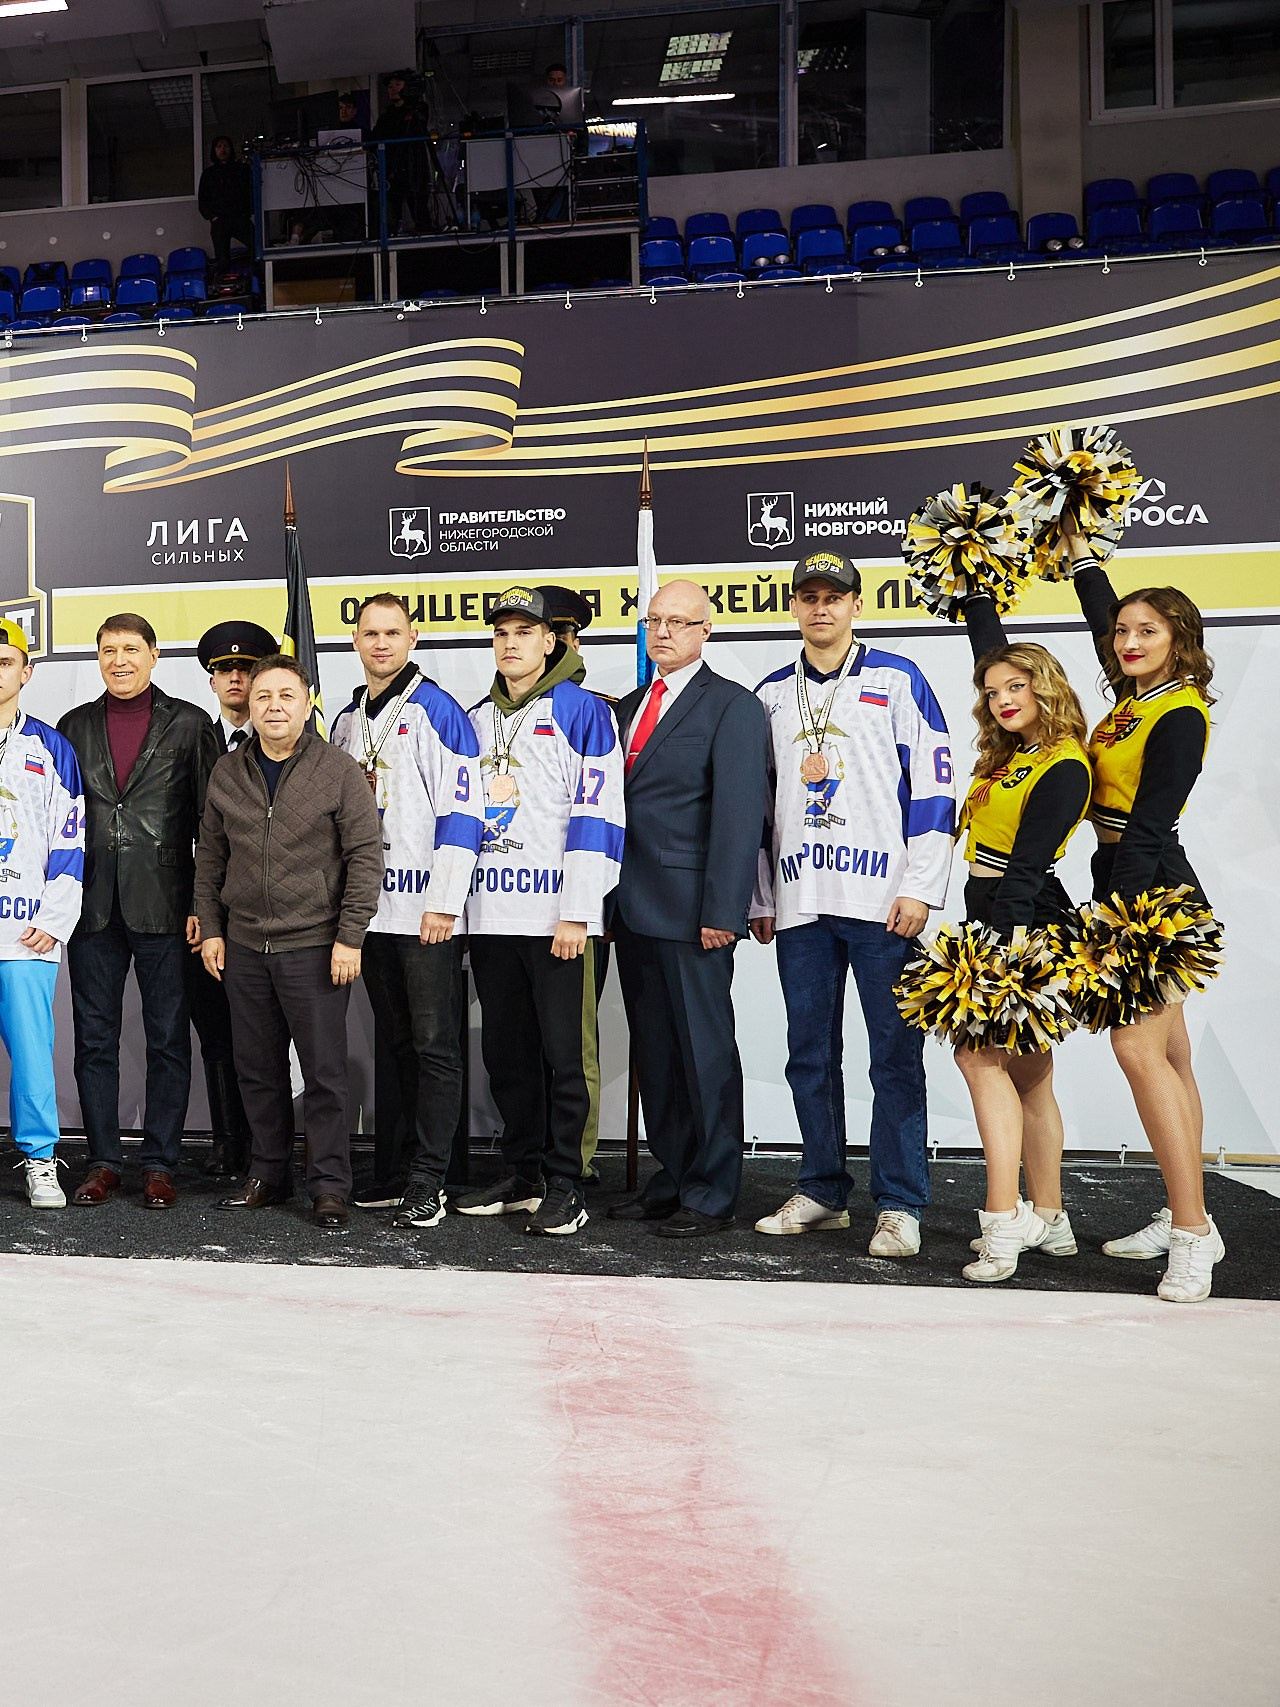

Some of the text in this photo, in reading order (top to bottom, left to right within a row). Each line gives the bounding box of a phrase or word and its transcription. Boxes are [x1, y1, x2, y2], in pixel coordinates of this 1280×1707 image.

[439, 507, 567, 524] ПРАВИТЕЛЬСТВО
[804, 497, 888, 518] НИЖНИЙ
[1120, 503, 1210, 528] РОСА
[146, 517, 249, 548] ЛИГА
[439, 523, 555, 541] НИЖЕГОРОДСКОЙ
[804, 519, 907, 538] НОВГОРОД
[439, 540, 500, 554] ОБЛАСТИ
[151, 548, 245, 566] СИЛЬНЫХ
[455, 765, 470, 802] 9
